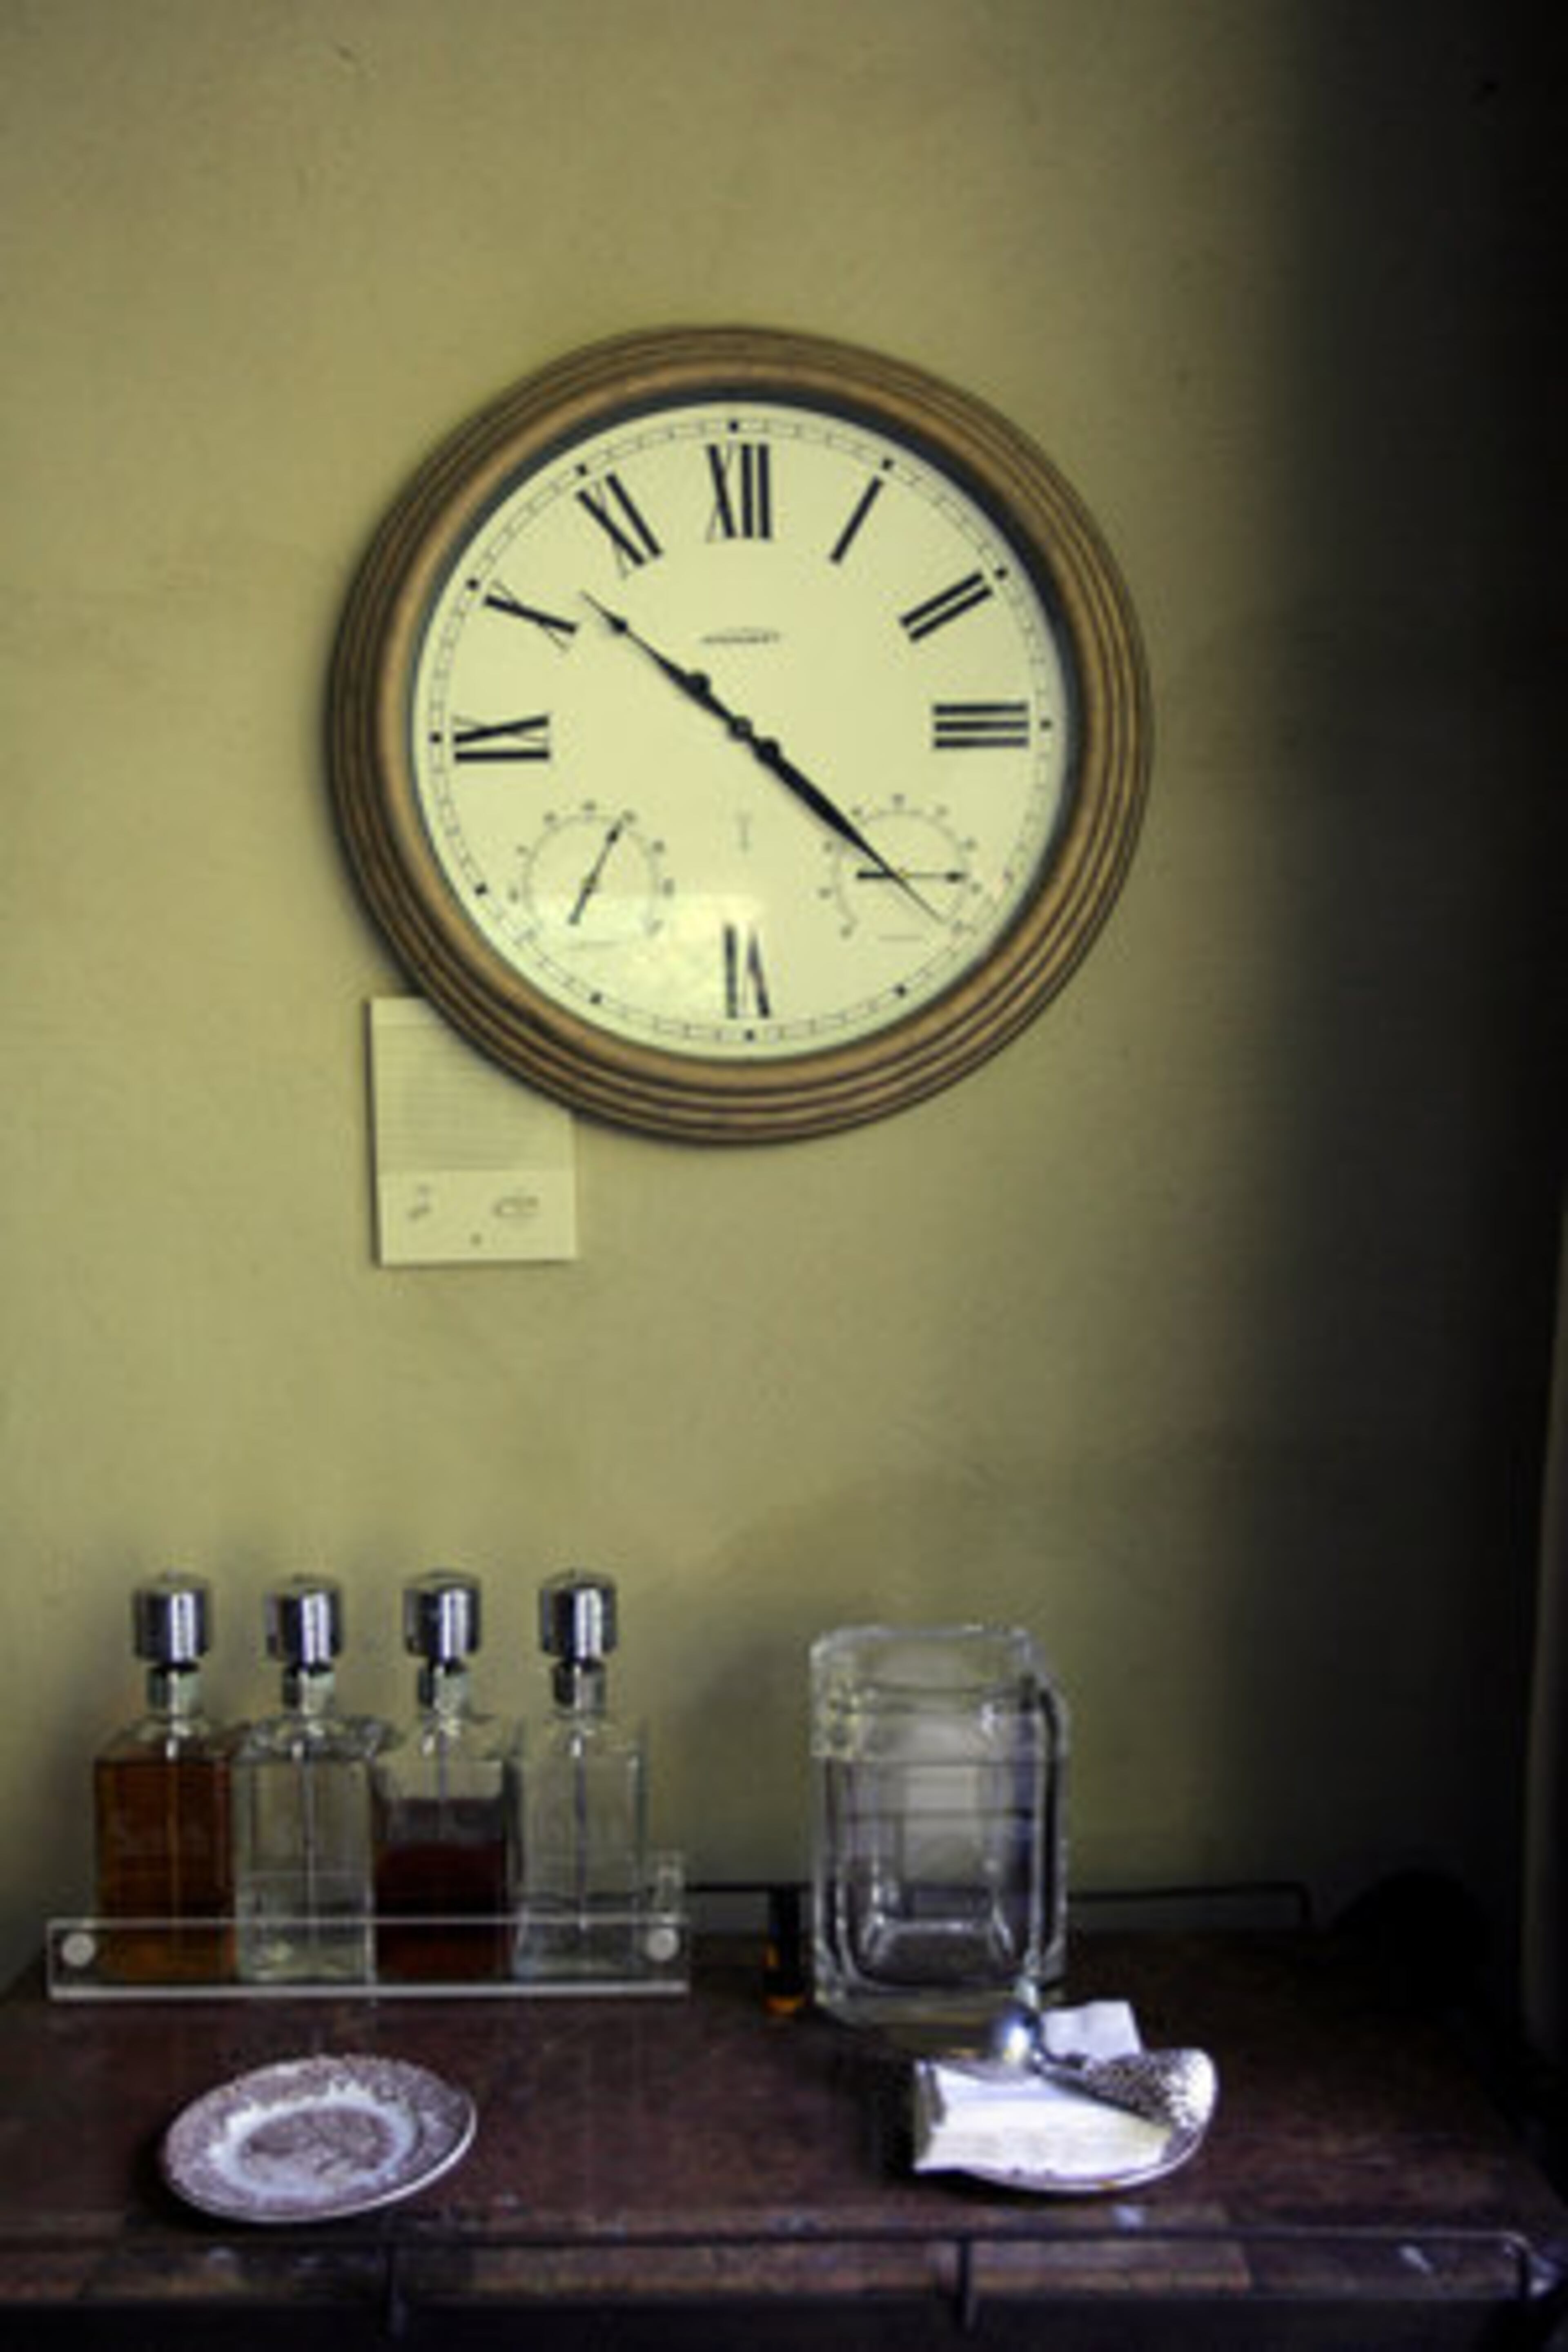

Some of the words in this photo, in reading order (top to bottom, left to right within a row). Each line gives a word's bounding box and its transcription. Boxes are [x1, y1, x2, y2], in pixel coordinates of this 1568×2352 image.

[576, 473, 663, 579] XI
[705, 442, 773, 543] XII
[830, 476, 882, 563] I
[484, 581, 578, 654] X
[900, 572, 994, 642] II
[453, 715, 551, 762] IX
[932, 703, 1029, 748] III
